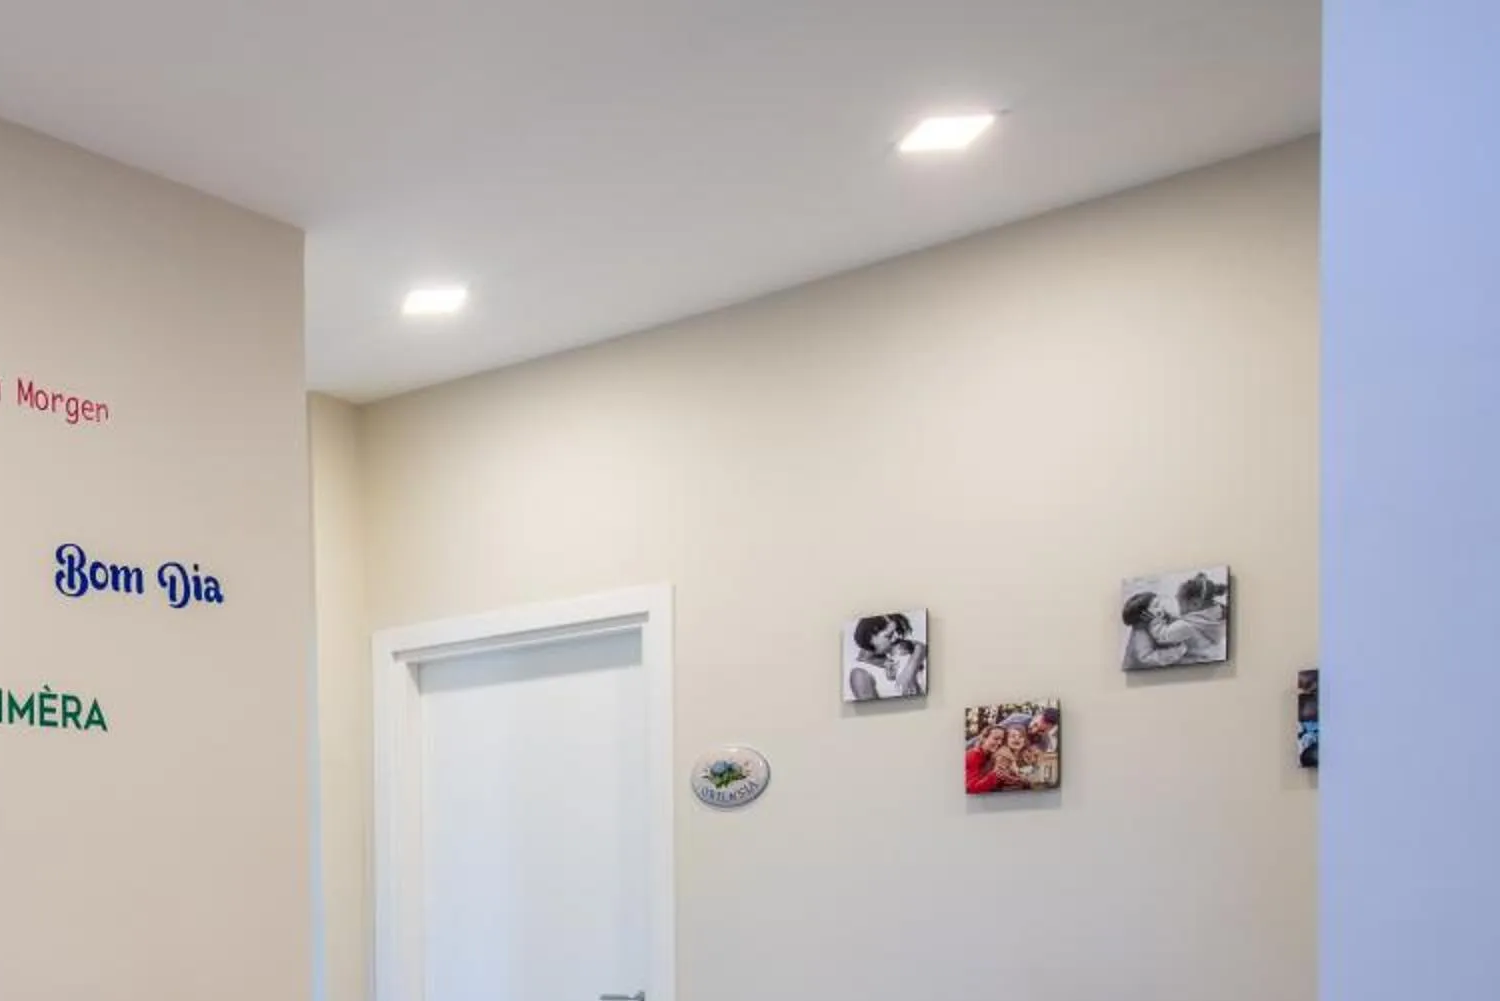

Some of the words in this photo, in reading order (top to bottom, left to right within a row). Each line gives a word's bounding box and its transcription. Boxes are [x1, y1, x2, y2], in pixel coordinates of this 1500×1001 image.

[17, 377, 109, 424] Morgen
[55, 543, 145, 597] Bom
[157, 562, 224, 608] Dia
